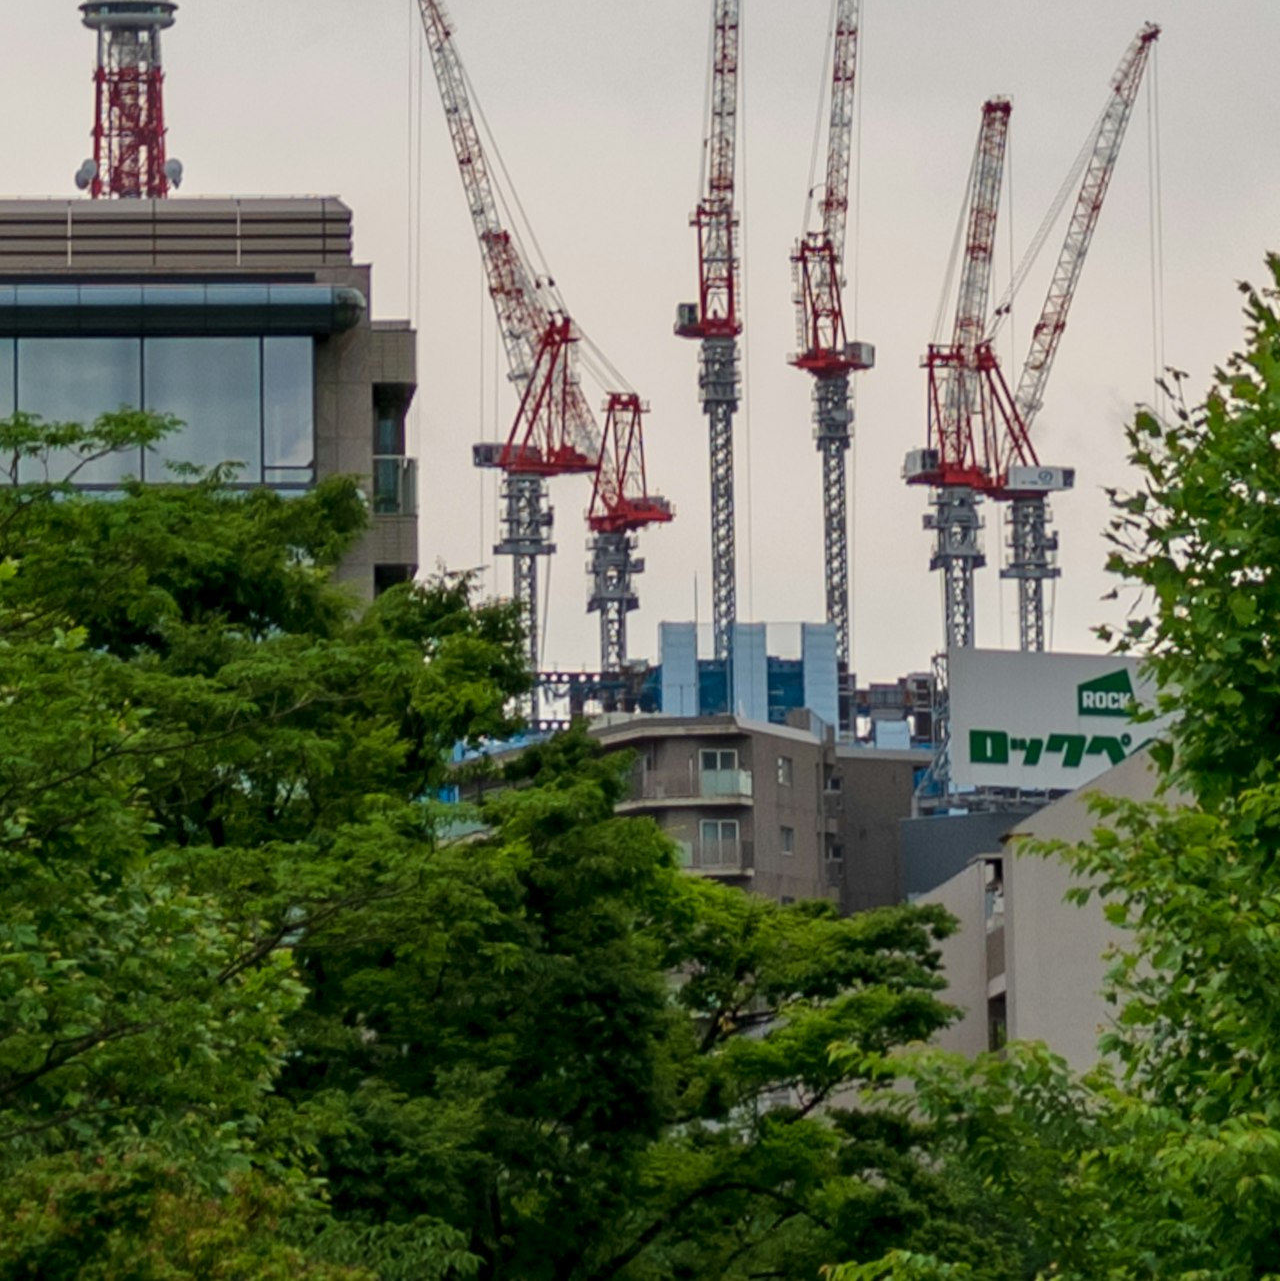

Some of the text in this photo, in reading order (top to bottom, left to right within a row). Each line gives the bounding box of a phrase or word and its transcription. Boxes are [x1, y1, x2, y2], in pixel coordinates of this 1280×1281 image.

[1082, 690, 1132, 709] ROCK
[969, 729, 1155, 768] ロックペ
